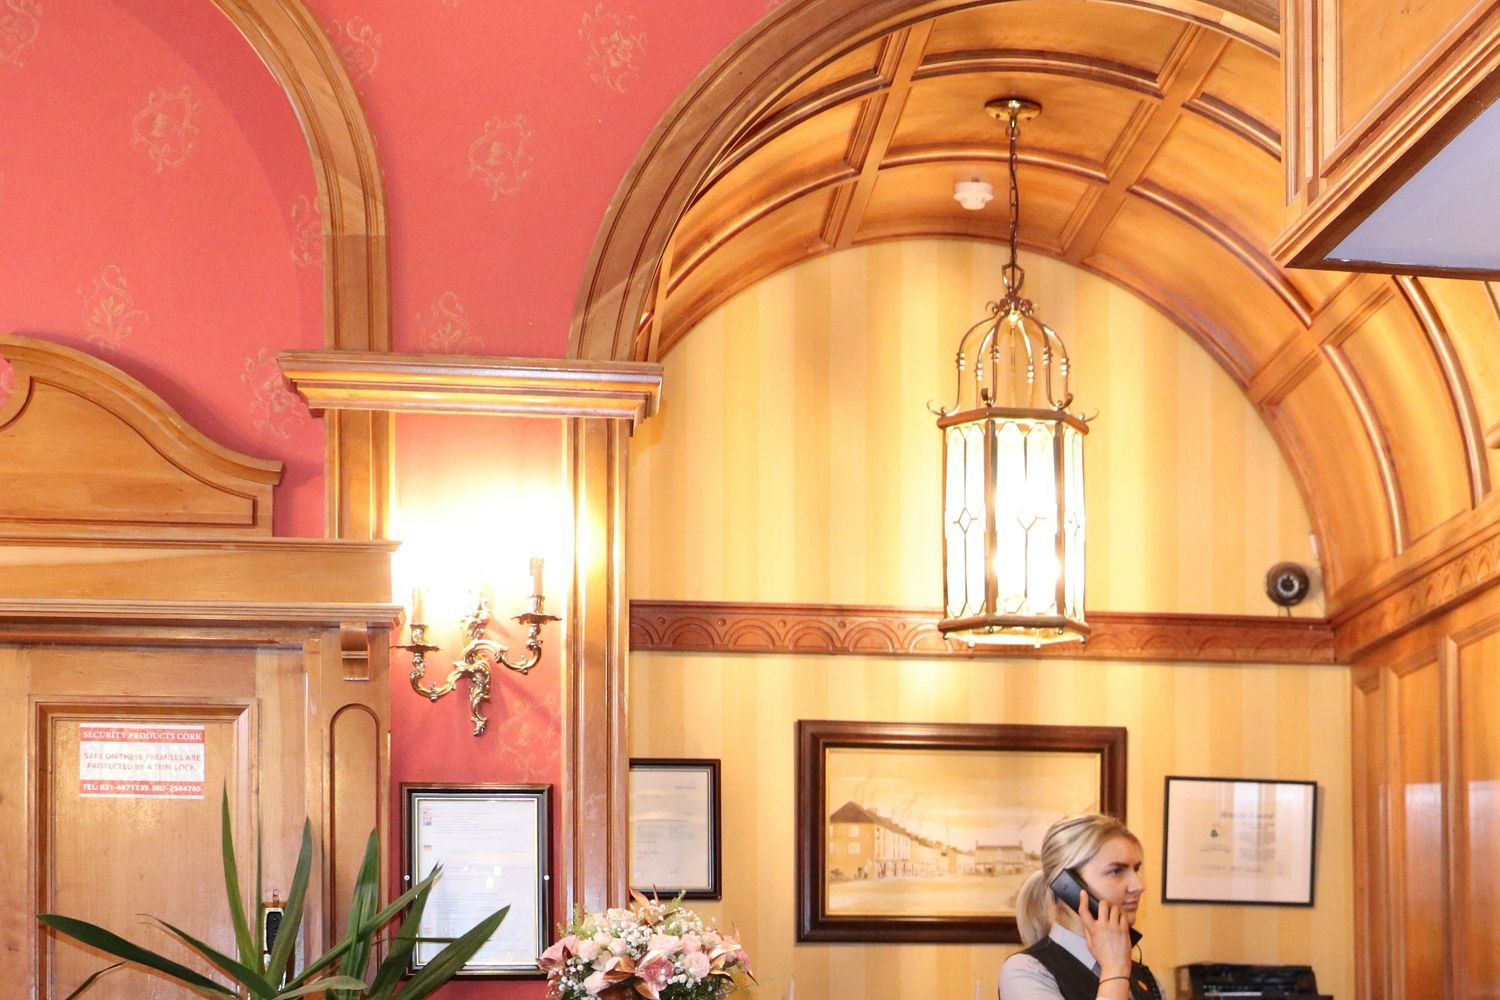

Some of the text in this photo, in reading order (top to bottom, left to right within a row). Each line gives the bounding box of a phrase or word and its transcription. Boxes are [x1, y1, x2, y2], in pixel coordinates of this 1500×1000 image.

[83, 731, 127, 739] SECURITY
[177, 732, 202, 740] CORK
[83, 752, 104, 760] SAFE
[145, 753, 184, 761] PREMISES
[87, 762, 134, 770] PROTECTED
